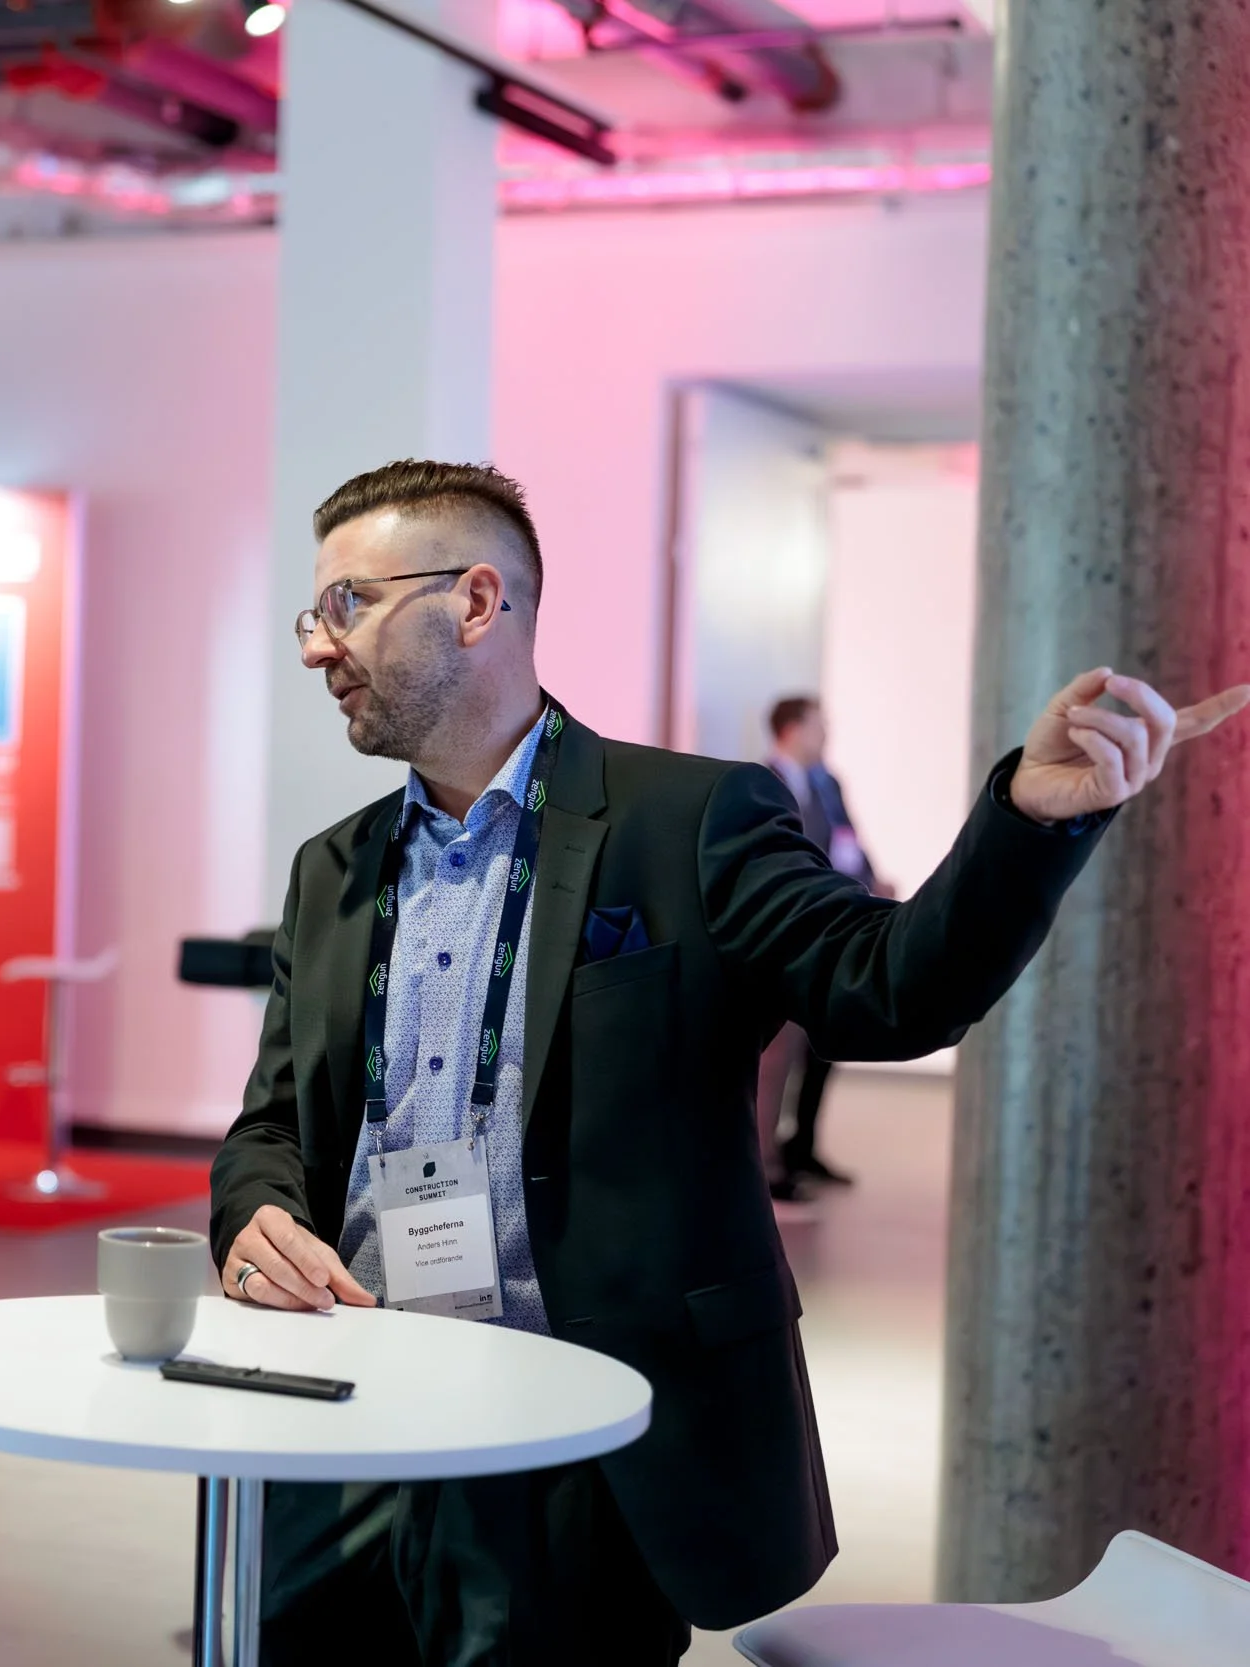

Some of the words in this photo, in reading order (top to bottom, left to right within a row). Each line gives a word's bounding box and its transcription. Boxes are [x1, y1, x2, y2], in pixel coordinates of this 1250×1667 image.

[545, 709, 557, 738] zengun
[527, 779, 539, 810] zengun
[510, 858, 522, 892] zengun
[385, 885, 395, 917] zengun
[494, 942, 506, 976] zengun
[377, 963, 387, 995] zengun
[480, 1029, 490, 1064] zengun
[374, 1045, 383, 1080] zengun
[405, 1179, 458, 1195] CONSTRUCTION
[419, 1190, 446, 1201] SUMMIT
[408, 1220, 464, 1236] Byggcheferna
[415, 1259, 429, 1267] Vice
[430, 1255, 463, 1266] ordförande
[417, 1242, 441, 1251] Anders
